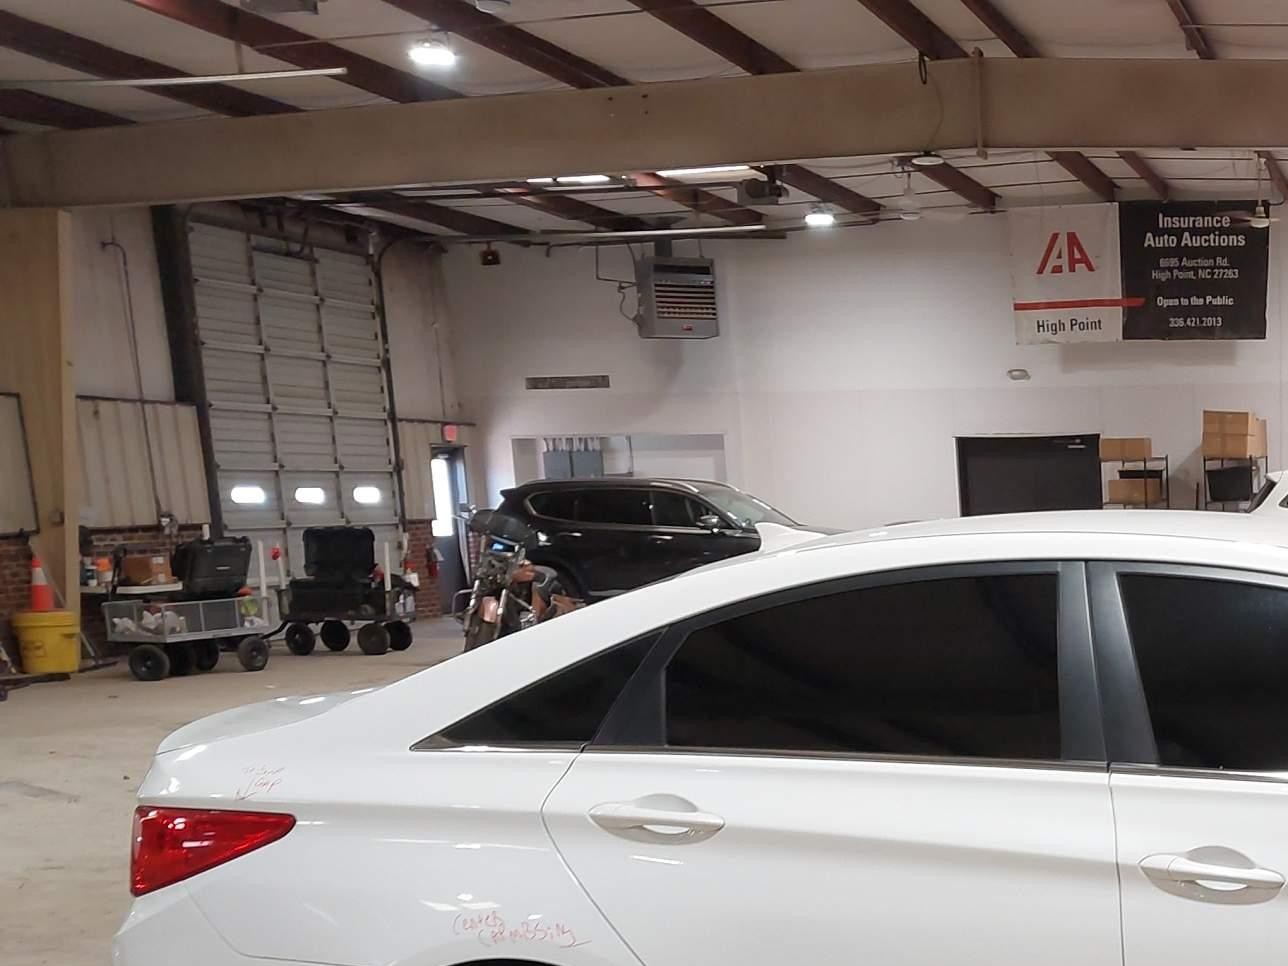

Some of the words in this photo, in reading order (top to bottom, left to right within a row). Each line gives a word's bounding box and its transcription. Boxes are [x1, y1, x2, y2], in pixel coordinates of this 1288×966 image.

[1158, 213, 1231, 229] Insurance
[1144, 233, 1177, 248] Auto
[1181, 231, 1246, 247] Auctions
[1181, 257, 1214, 267] Auction
[1152, 270, 1171, 281] High
[1198, 269, 1212, 279] NC
[1213, 268, 1239, 279] 27263
[1157, 296, 1179, 308] Open
[1180, 296, 1189, 306] to
[1190, 296, 1204, 306] the
[1206, 295, 1234, 306] Public
[1036, 320, 1067, 335] High
[1070, 318, 1102, 333] Point
